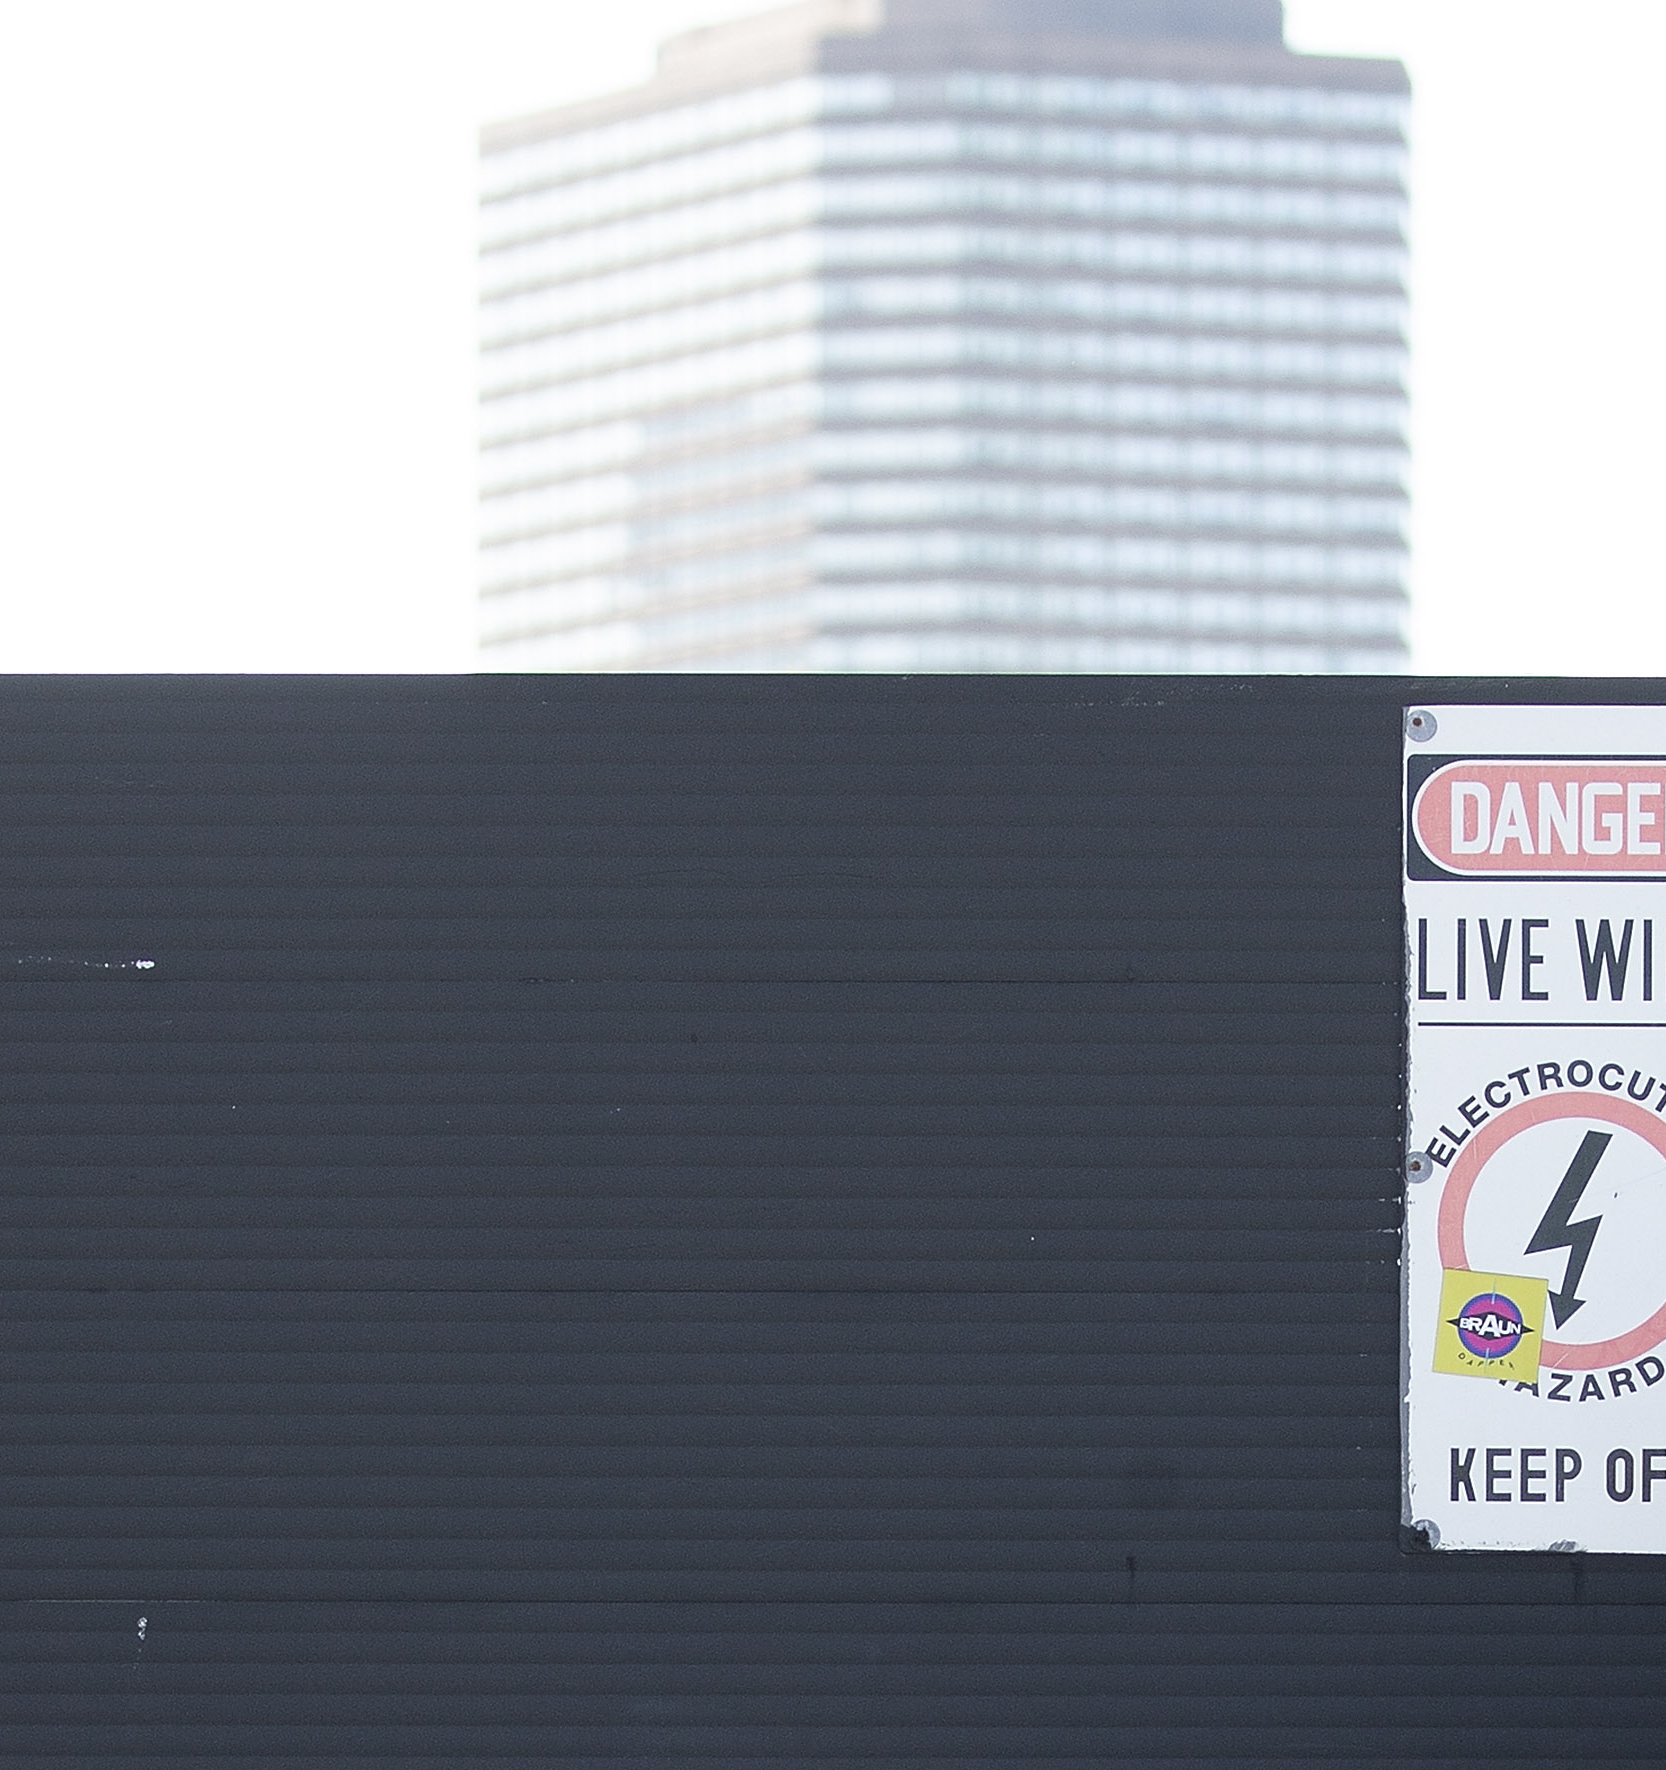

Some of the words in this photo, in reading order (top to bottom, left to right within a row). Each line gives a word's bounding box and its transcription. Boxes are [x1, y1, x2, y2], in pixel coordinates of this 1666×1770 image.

[1418, 918, 1549, 1001] LIVE
[1459, 1314, 1521, 1338] BRAUN
[1499, 1356, 1665, 1402] AZARD
[1450, 1447, 1583, 1502] KEEP
